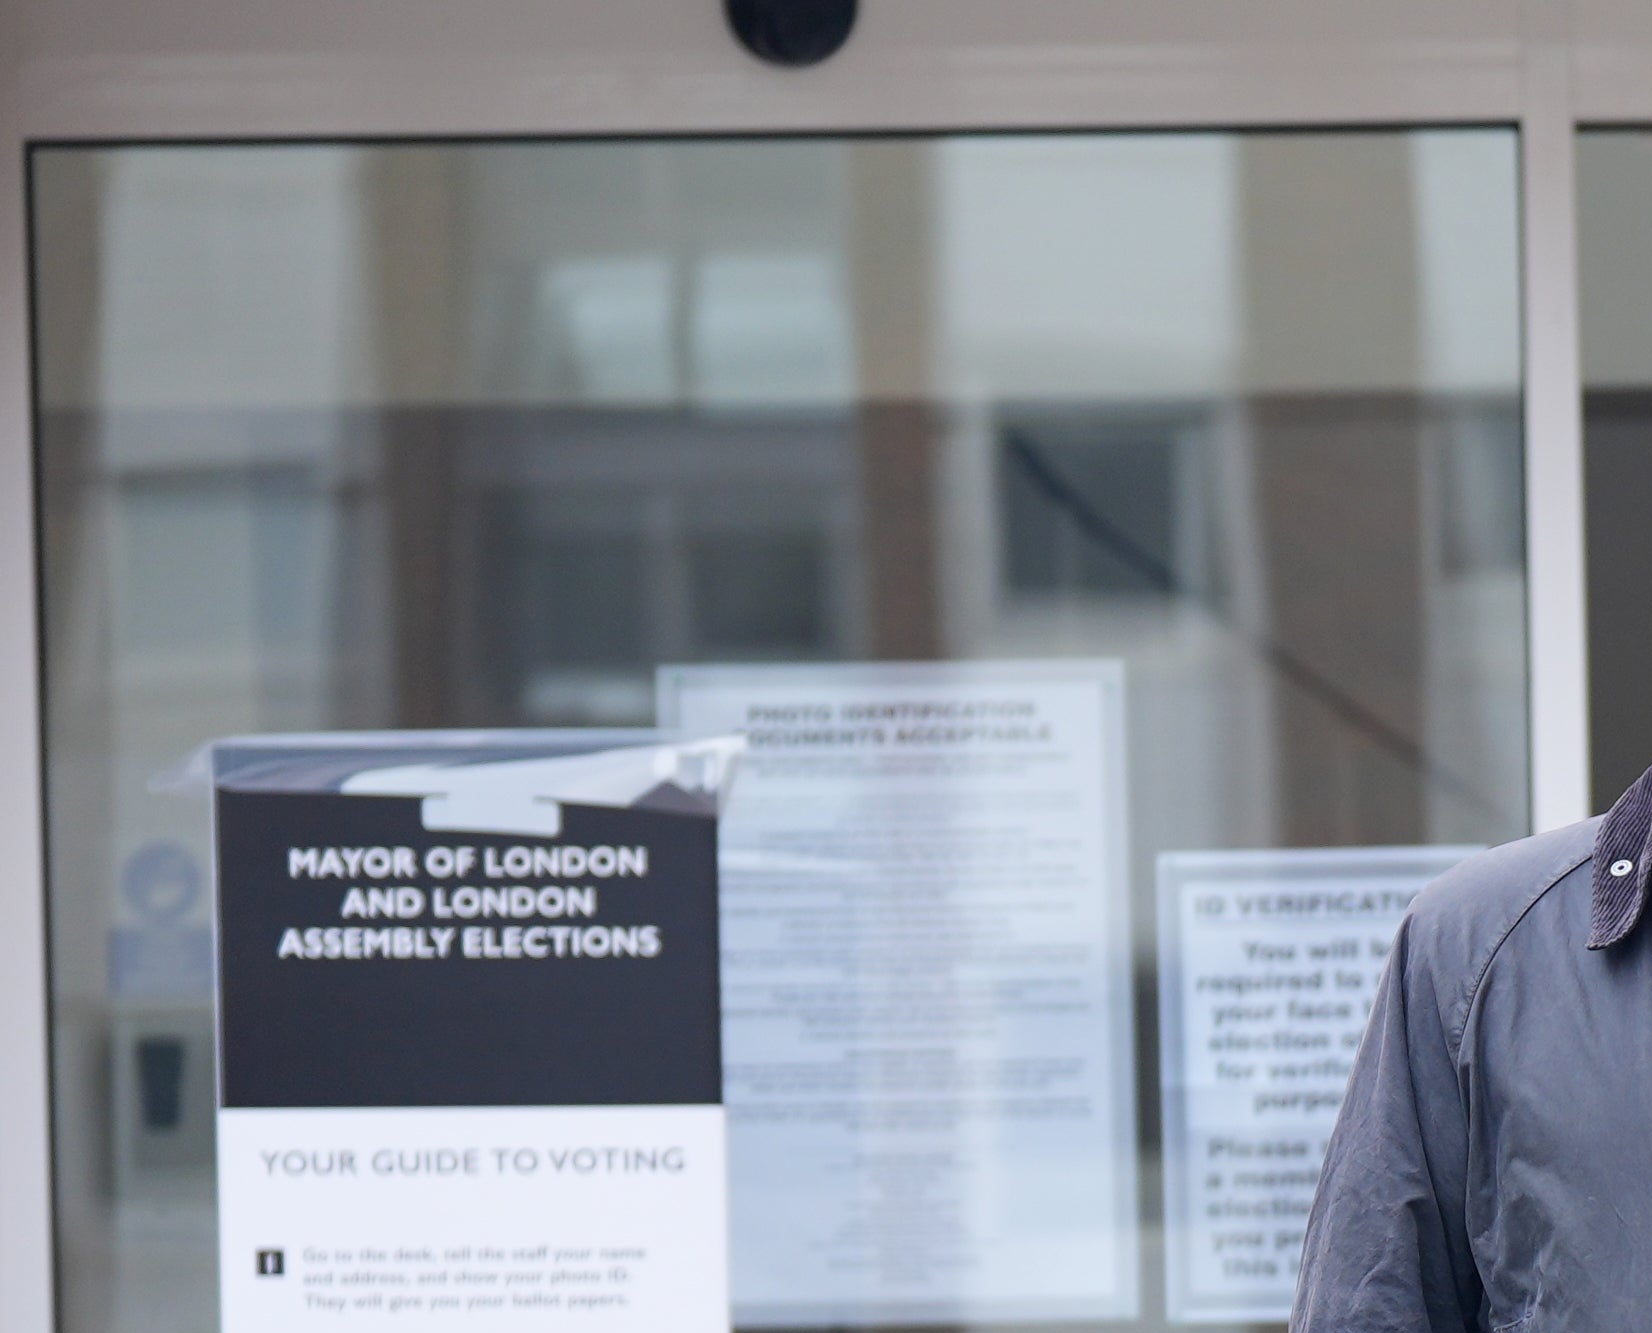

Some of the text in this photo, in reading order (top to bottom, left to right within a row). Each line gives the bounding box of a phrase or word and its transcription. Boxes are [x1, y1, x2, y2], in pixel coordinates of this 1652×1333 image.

[735, 725, 886, 746] OCUMENTS
[288, 846, 648, 878] MAYOR OF LONDON
[341, 886, 597, 919] AND LONDON
[278, 926, 662, 959] ASSEMBLY ELECTIONS
[259, 1146, 688, 1177] YOUR GUIDE TO VOTING
